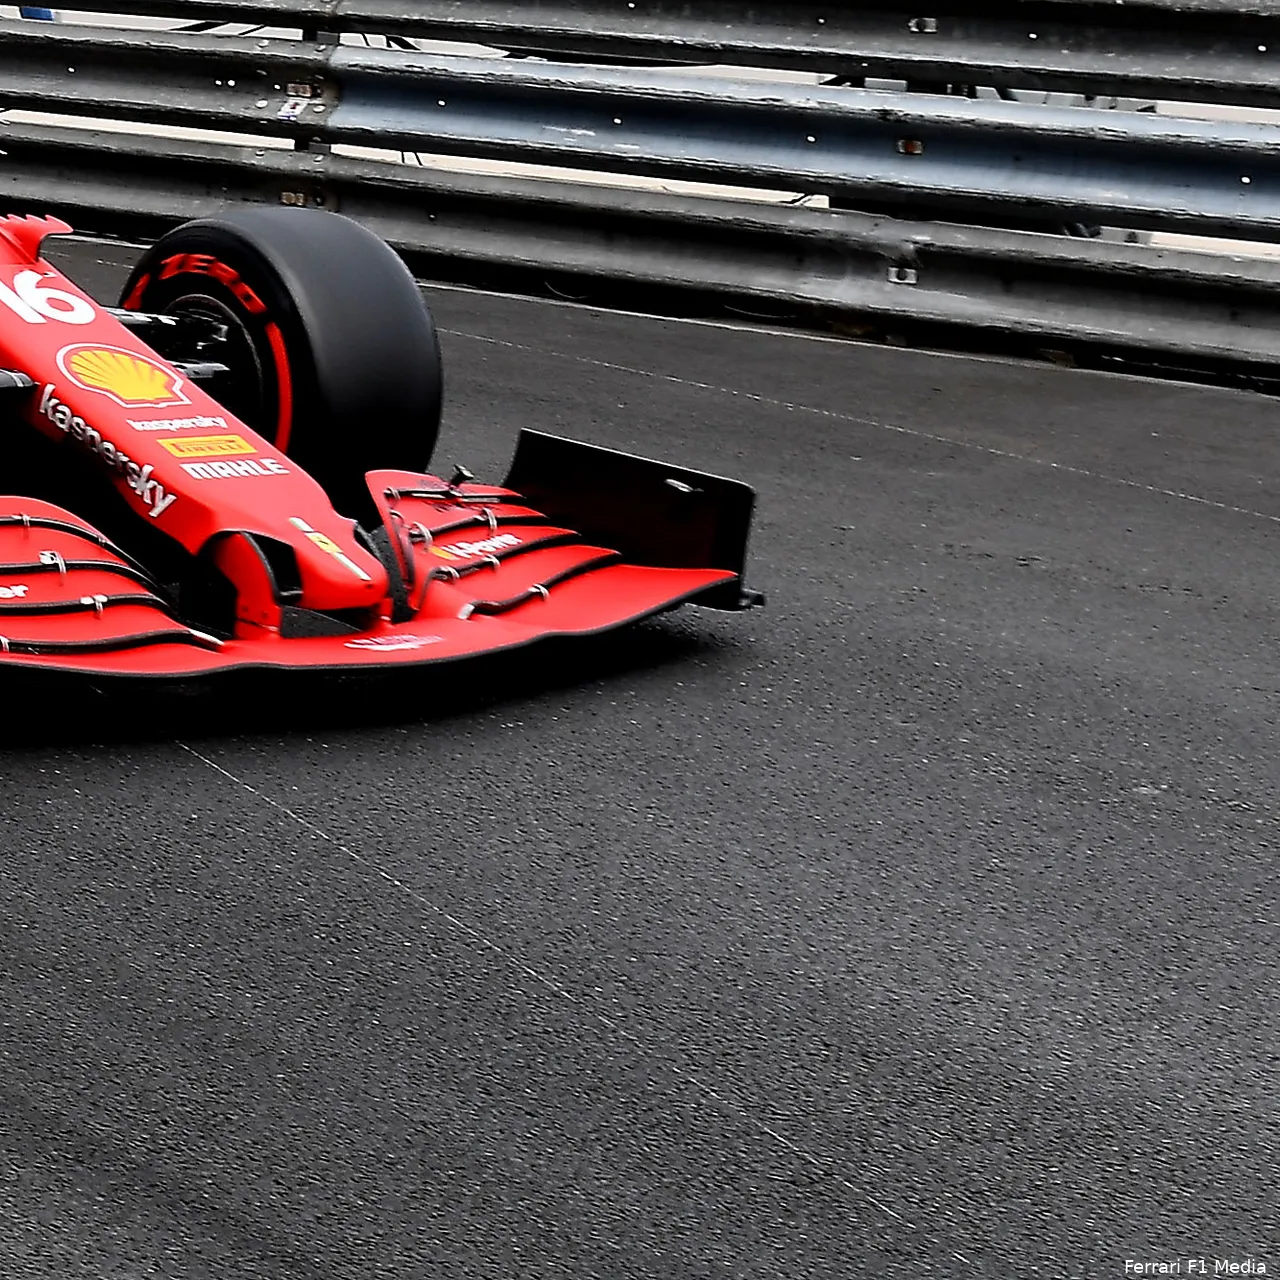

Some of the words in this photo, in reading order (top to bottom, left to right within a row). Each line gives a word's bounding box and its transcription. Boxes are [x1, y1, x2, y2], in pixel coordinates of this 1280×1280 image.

[126, 415, 229, 432] kaspersky
[40, 383, 178, 518] kaspersky
[180, 458, 290, 481] MAHLE
